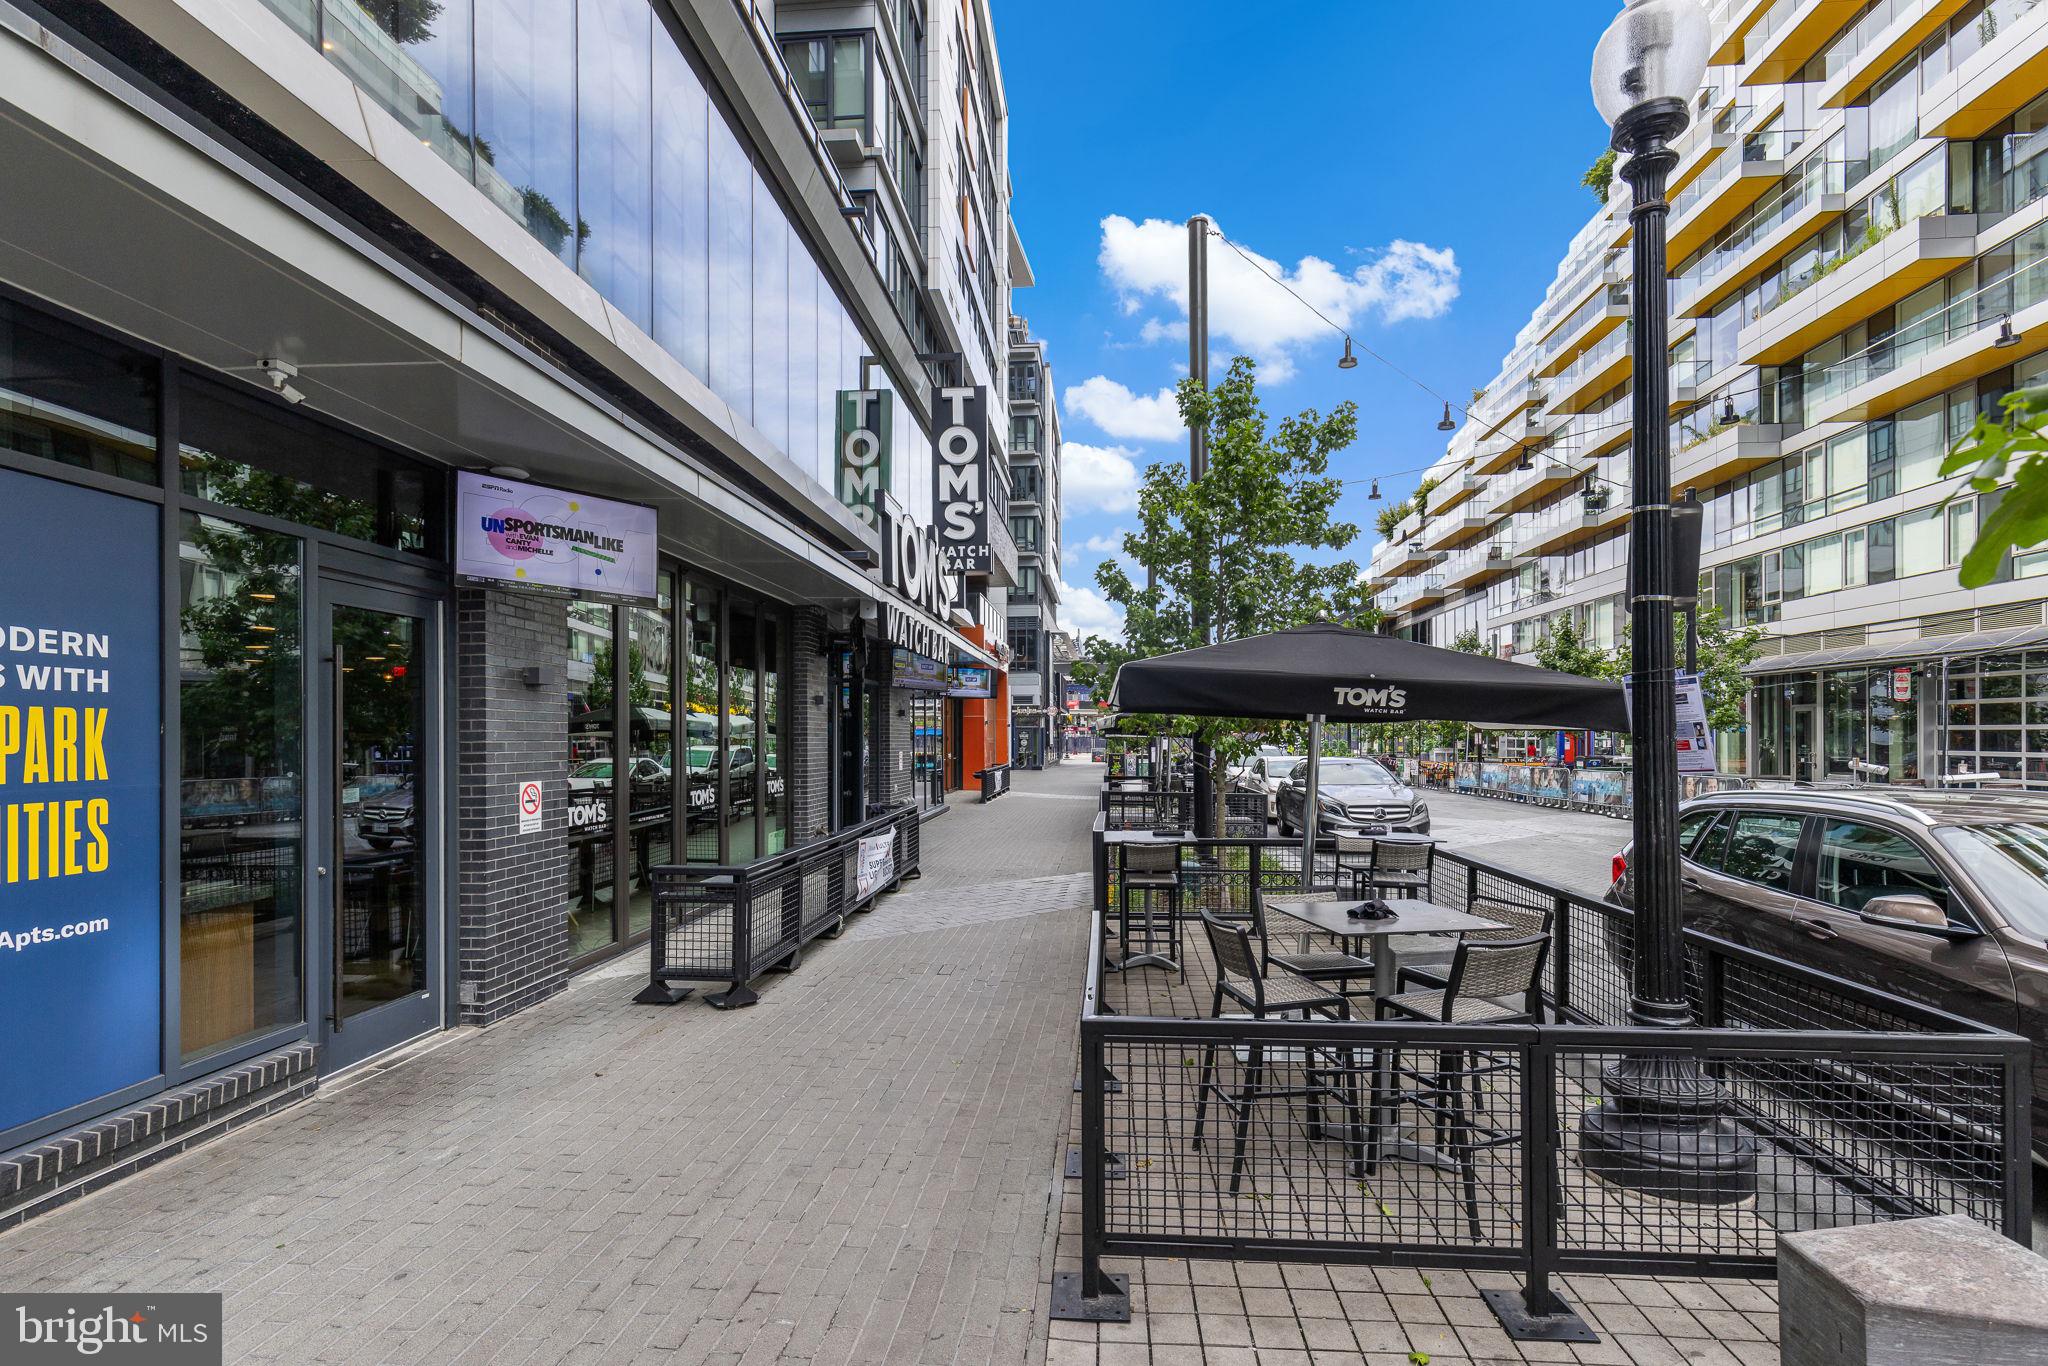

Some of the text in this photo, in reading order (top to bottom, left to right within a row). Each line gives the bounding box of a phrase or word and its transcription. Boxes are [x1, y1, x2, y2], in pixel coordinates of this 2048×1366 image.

[481, 516, 624, 553] UNSPORTSMANLIKE
[505, 538, 532, 548] CANTY
[517, 545, 554, 557] MICHELLE
[885, 491, 951, 622] TOM'S
[0, 625, 109, 659] DERN
[886, 602, 929, 658] WATCH
[931, 630, 950, 666] BAR
[15, 664, 109, 694] WITH
[1333, 684, 1407, 708] TOM'S
[0, 705, 109, 785] PARK
[690, 784, 715, 807] TOM'S
[767, 775, 784, 794] TOM'S
[567, 798, 607, 827] TOM'S
[0, 798, 109, 884] ITIES
